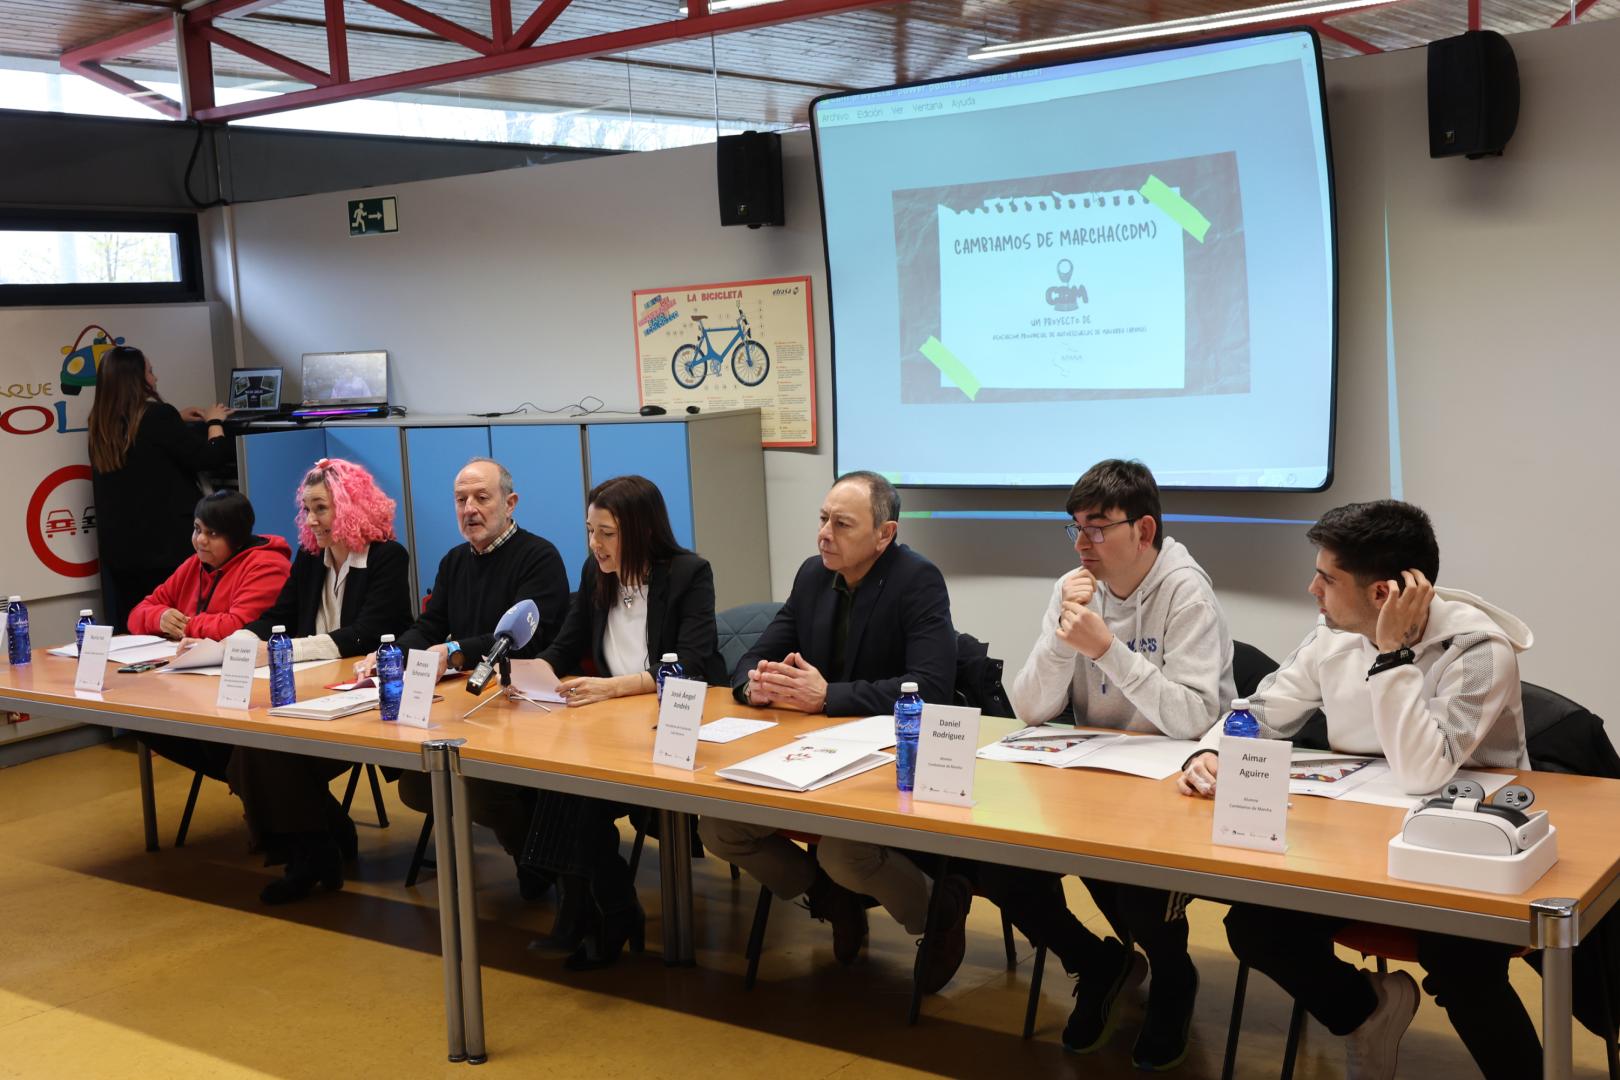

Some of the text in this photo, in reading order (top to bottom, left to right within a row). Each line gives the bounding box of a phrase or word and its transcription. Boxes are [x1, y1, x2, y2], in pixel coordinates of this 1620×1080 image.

[912, 101, 943, 113] Ventana
[951, 96, 976, 108] Ayuda
[954, 220, 1157, 255] CAMBIAMOS DE MARCHA(CDM)
[687, 289, 743, 303] LA BICICLETA
[1043, 315, 1080, 326] PROYECTO
[1082, 314, 1092, 325] DE
[939, 719, 961, 728] Daniel
[1241, 753, 1267, 764] Aimar
[1239, 768, 1270, 780] Aguirre
